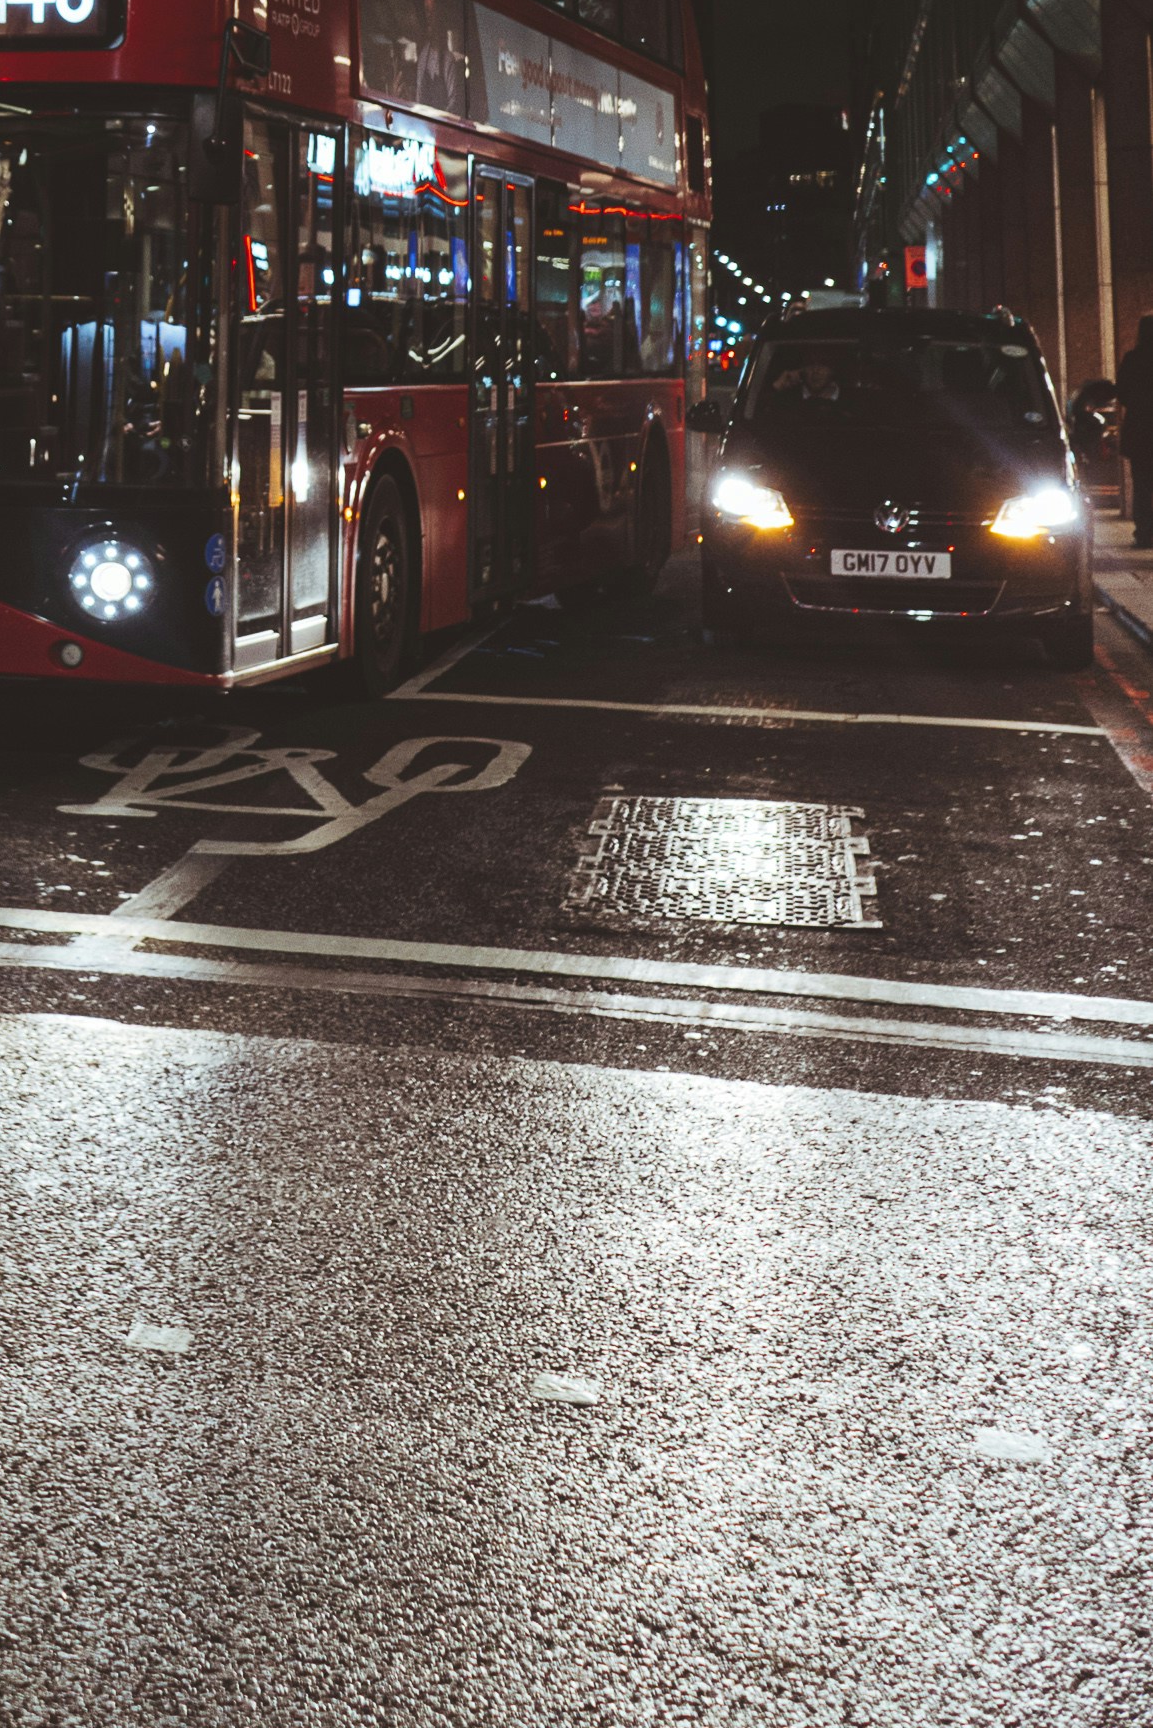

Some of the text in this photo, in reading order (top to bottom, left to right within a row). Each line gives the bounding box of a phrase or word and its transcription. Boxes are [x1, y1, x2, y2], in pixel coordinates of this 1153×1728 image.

[271, 10, 291, 26] RATP
[268, 71, 292, 95] LT122
[843, 552, 936, 574] GM17 OYV
